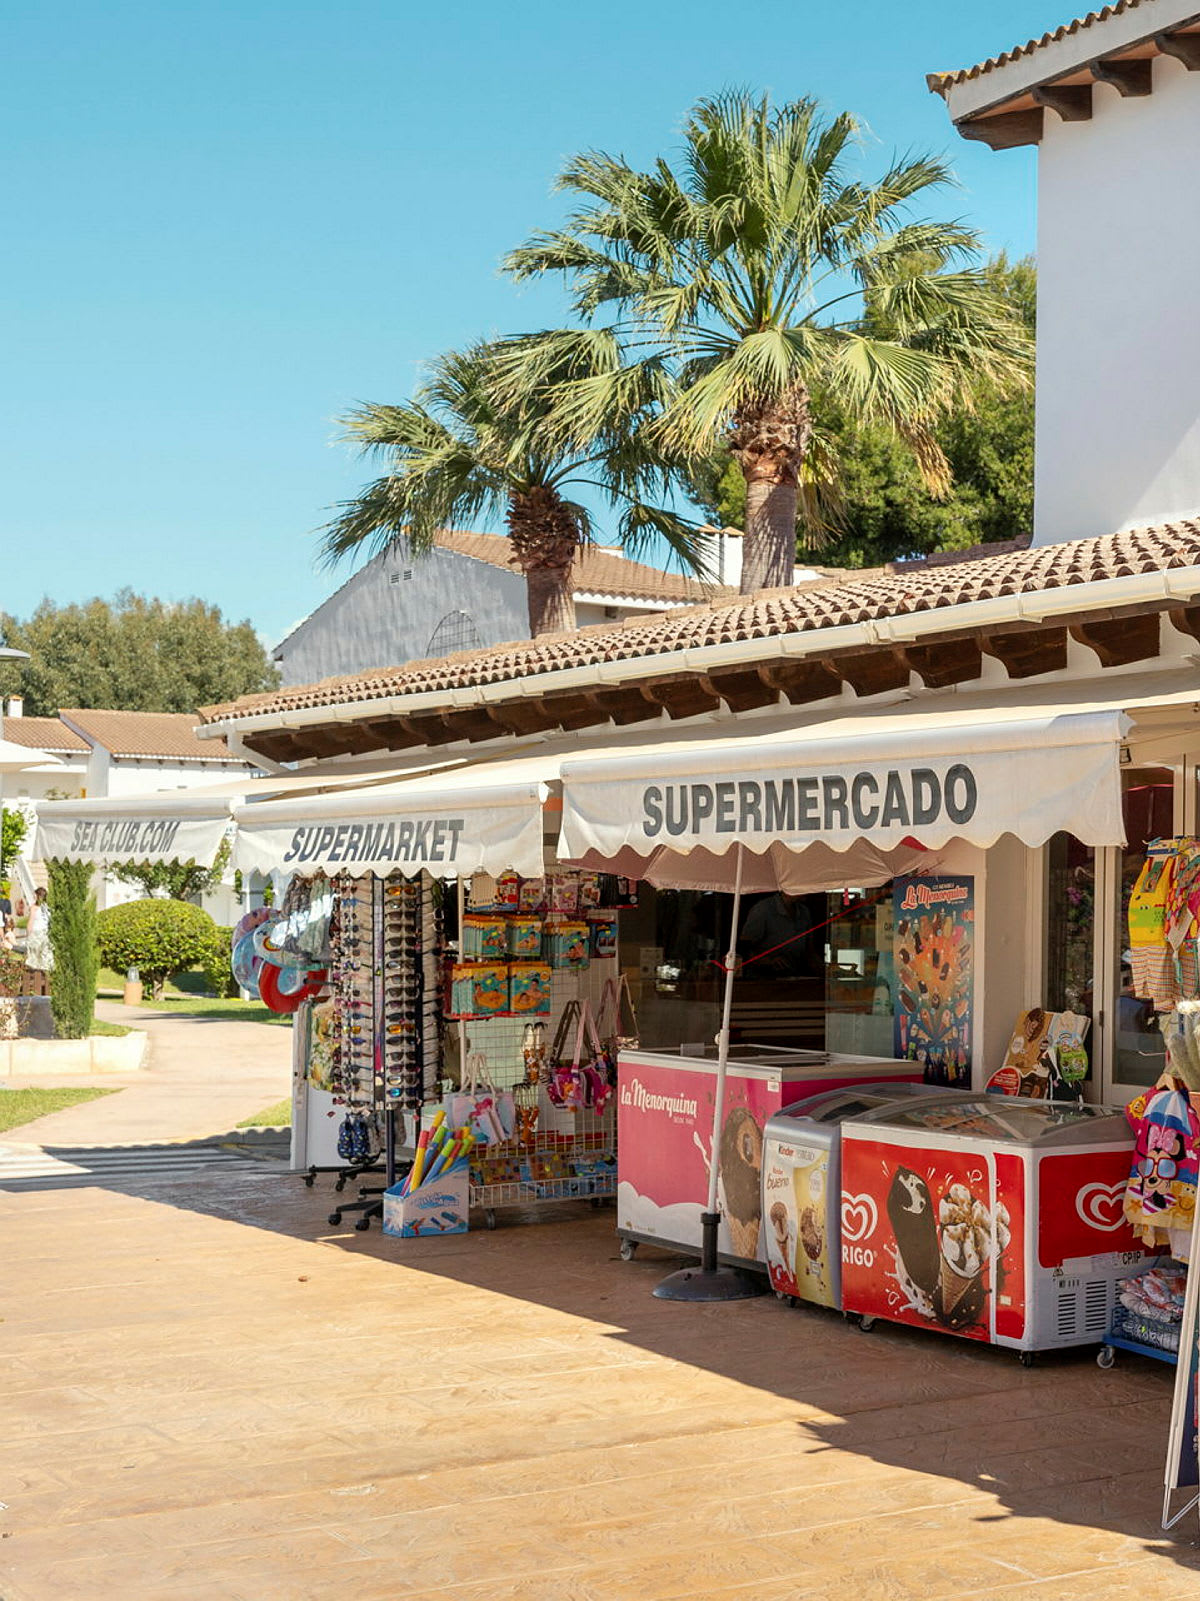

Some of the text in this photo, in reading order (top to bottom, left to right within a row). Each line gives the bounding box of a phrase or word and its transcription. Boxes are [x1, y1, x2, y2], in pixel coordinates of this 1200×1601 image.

[643, 763, 977, 837] SUPERMERCADO
[71, 821, 180, 853] SEA CLUB.COM
[284, 819, 465, 862] SUPERMARKET
[631, 1078, 698, 1118] Menorquina
